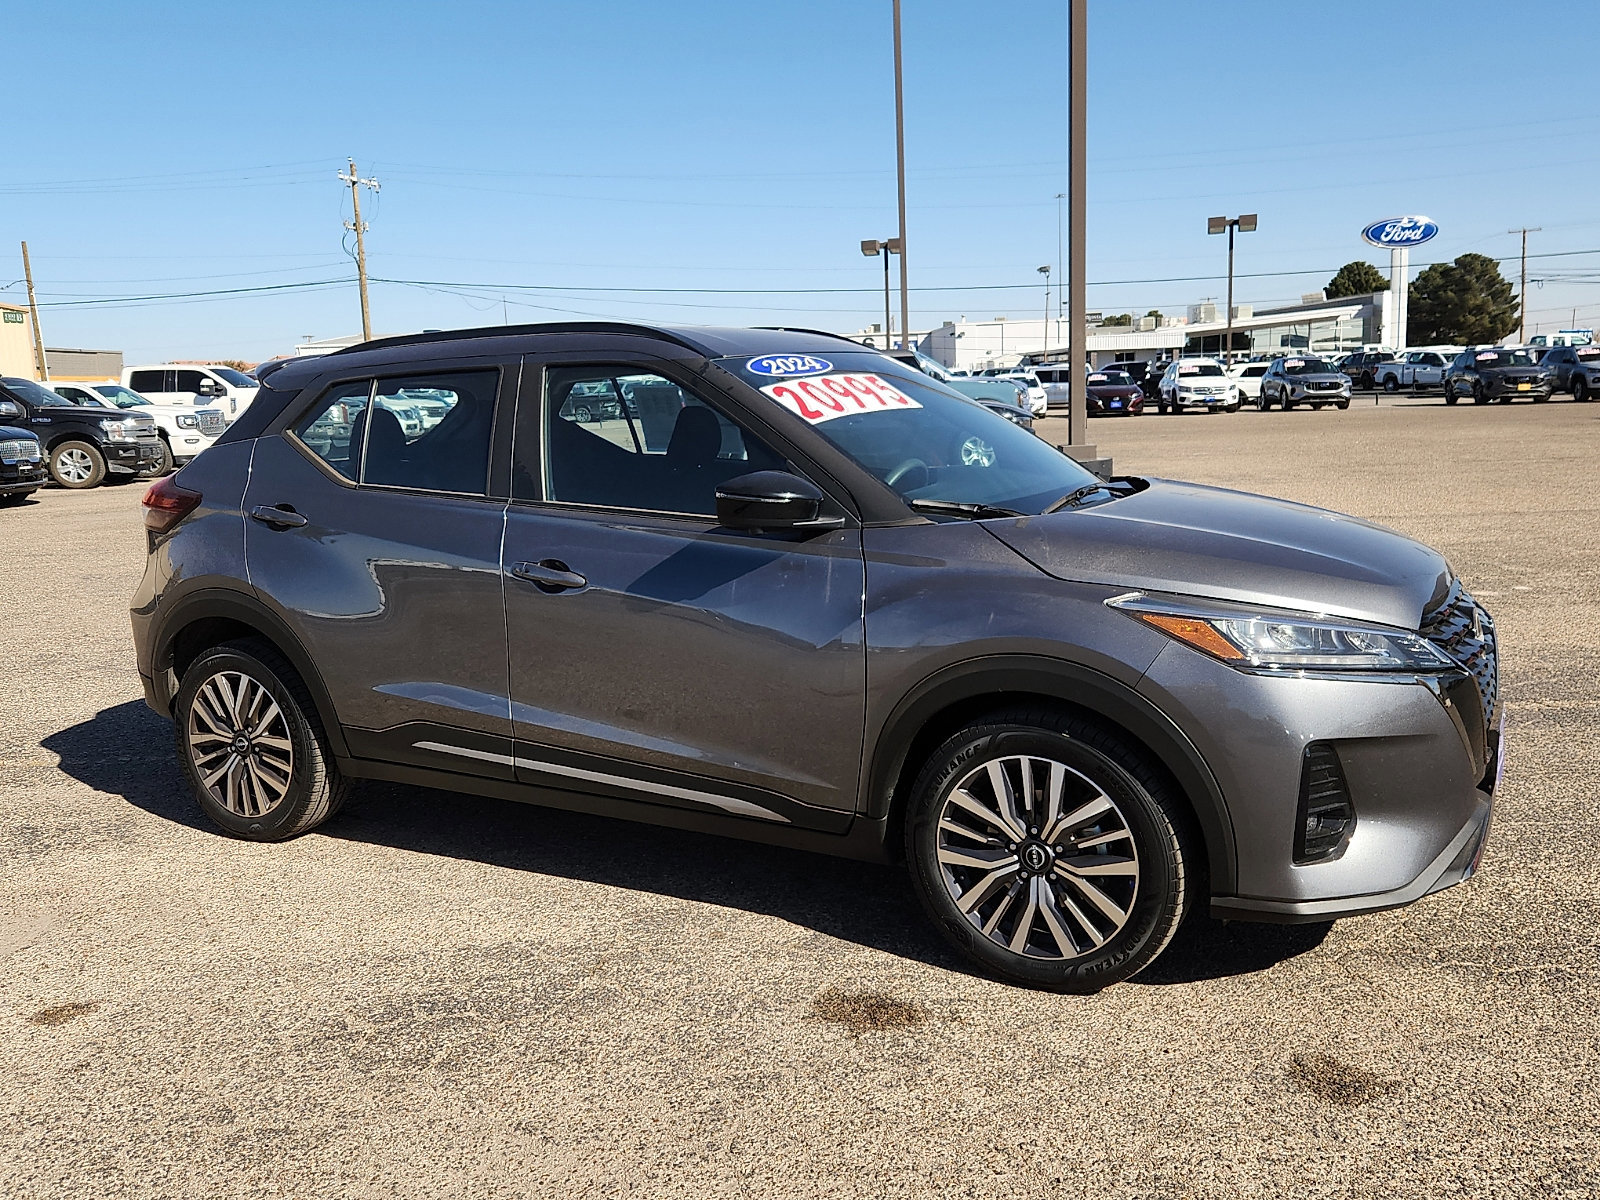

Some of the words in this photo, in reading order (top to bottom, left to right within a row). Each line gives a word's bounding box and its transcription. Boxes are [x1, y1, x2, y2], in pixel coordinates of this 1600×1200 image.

[1381, 221, 1423, 242] Ford
[763, 356, 823, 374] 2024
[772, 376, 908, 420] 20995
[1085, 914, 1152, 976] OODYEAR
